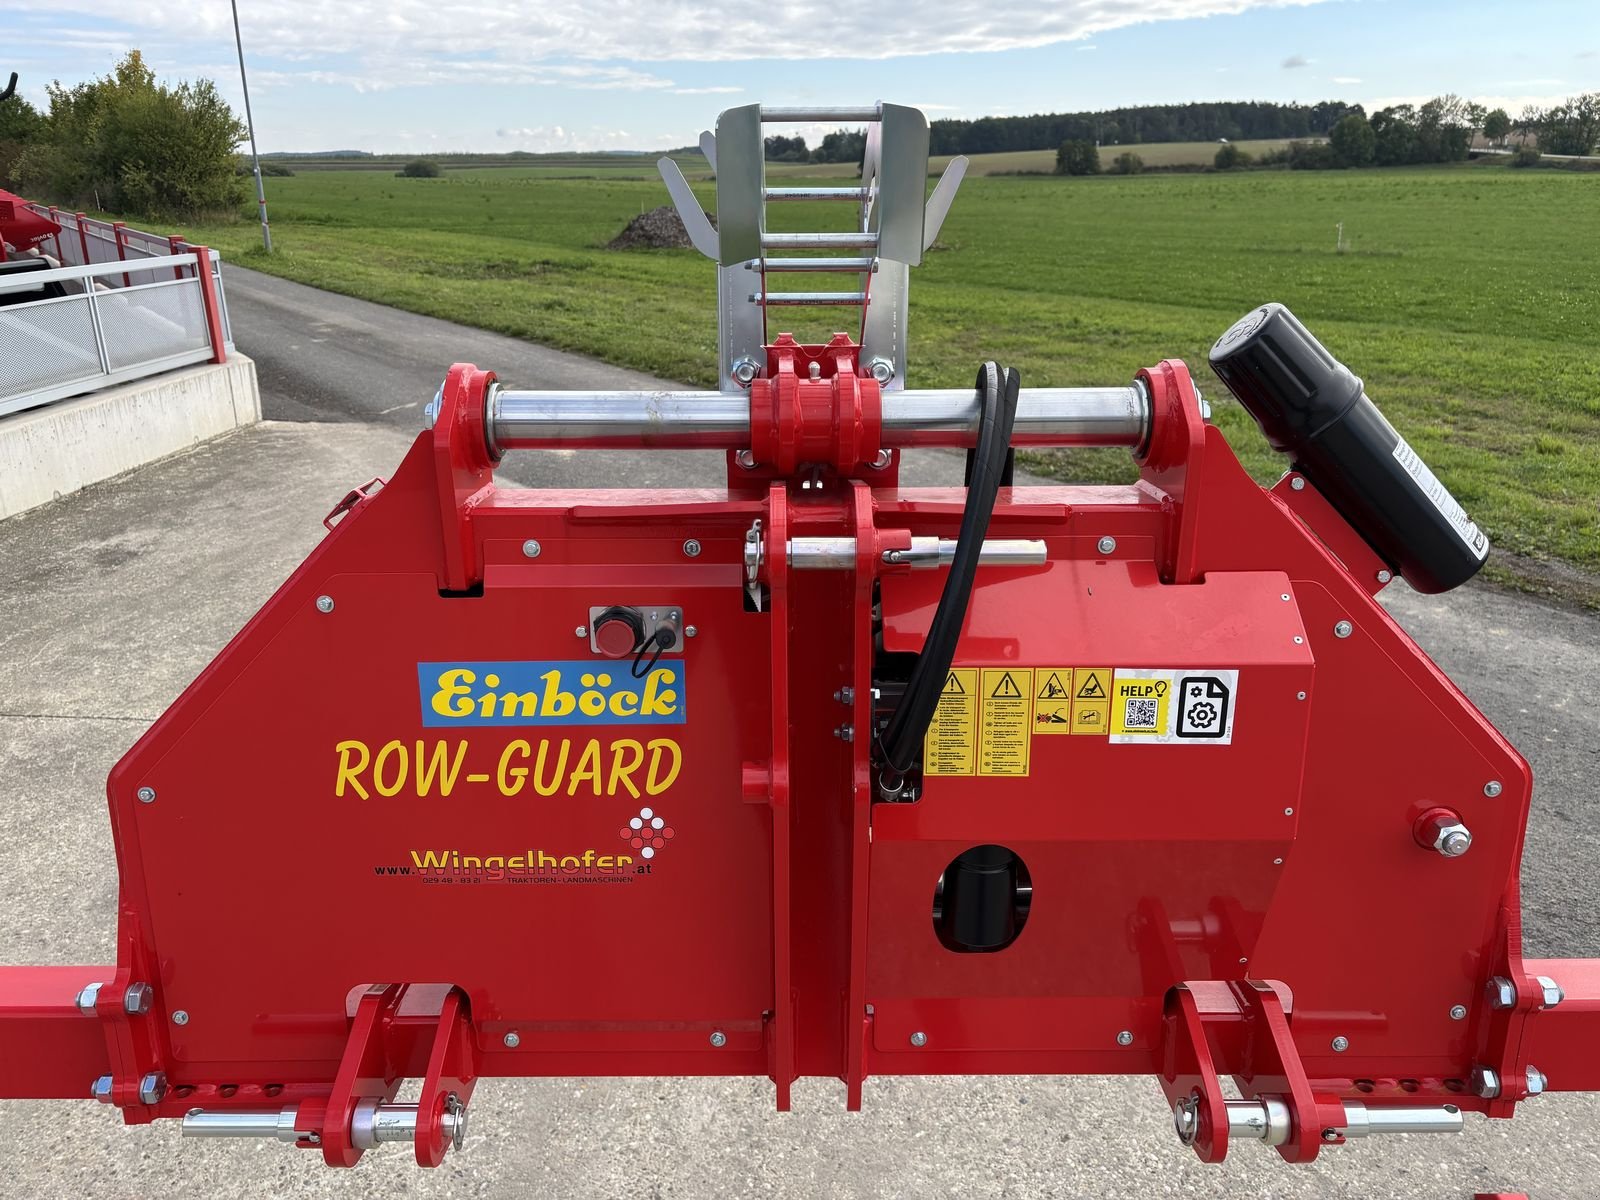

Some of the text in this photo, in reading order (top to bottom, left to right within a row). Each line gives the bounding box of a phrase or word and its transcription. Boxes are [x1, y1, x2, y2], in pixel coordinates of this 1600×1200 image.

[431, 668, 678, 718] Einböck
[1120, 685, 1153, 697] HELP
[335, 738, 683, 800] ROW-GUARD
